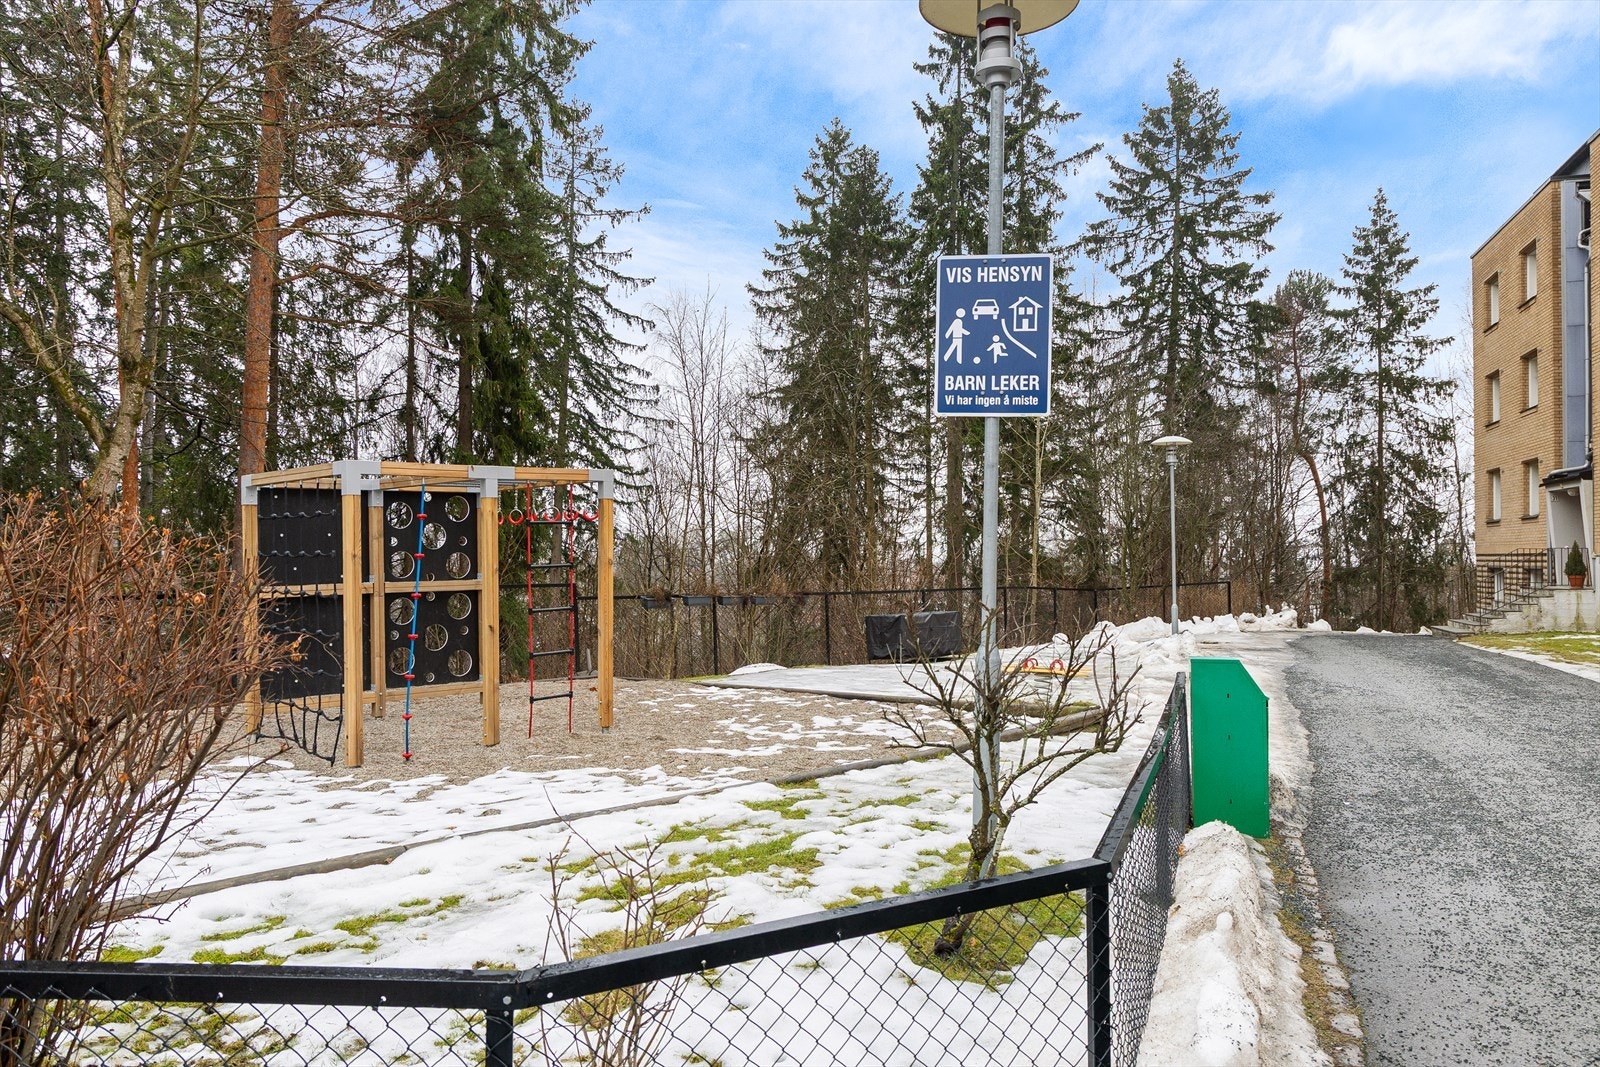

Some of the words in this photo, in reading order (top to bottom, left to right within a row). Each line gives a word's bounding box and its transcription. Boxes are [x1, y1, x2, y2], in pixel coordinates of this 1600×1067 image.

[946, 267, 972, 283] VIS
[977, 265, 1042, 283] HENSYN
[945, 375, 986, 391] BARN
[991, 375, 1040, 391] LEKER
[945, 395, 954, 404] Vi
[957, 395, 973, 404] har
[975, 395, 1000, 407] ingen
[1004, 394, 1009, 405] å
[1012, 395, 1038, 405] miste
